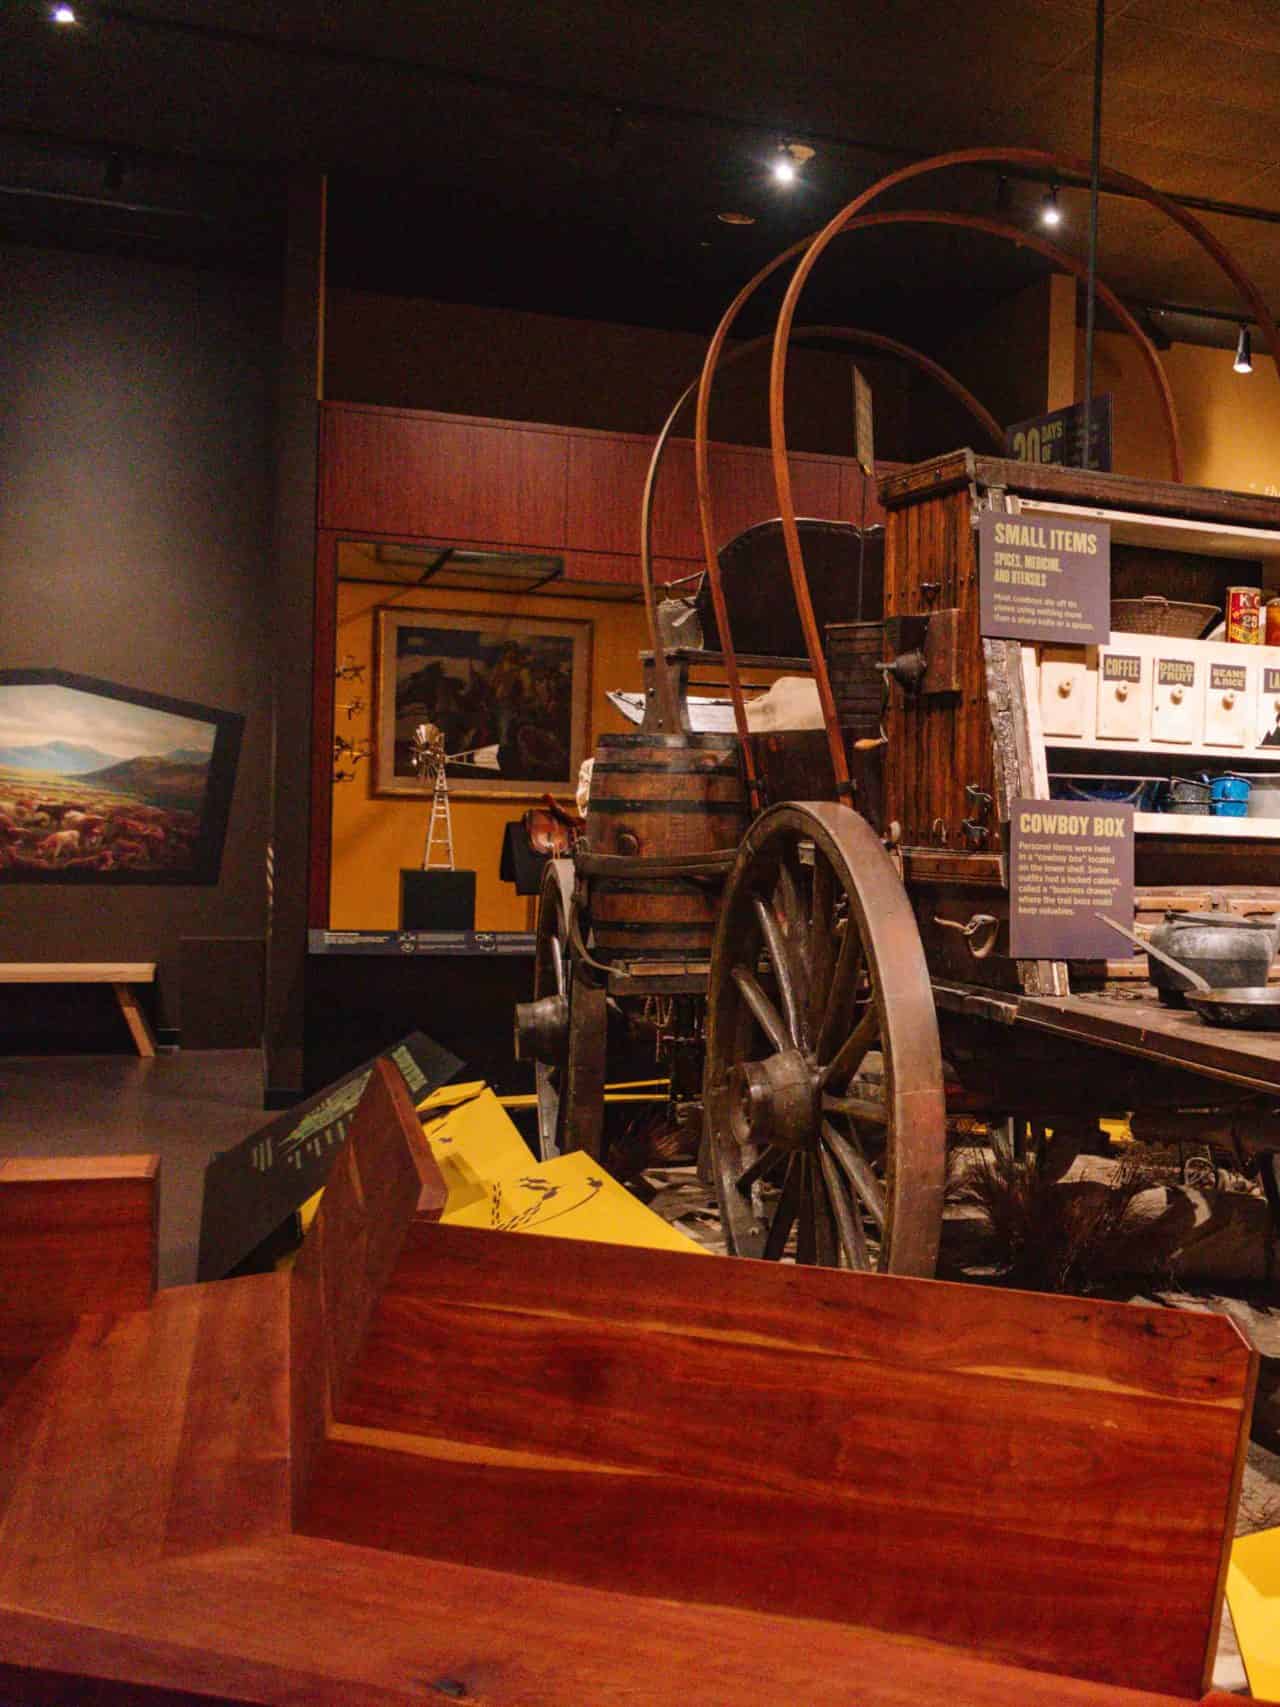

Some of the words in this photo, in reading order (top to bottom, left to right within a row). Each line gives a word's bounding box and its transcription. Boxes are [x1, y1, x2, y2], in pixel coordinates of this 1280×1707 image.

[1041, 420, 1063, 443] DAYS
[994, 521, 1047, 549] SMALL
[1049, 529, 1097, 555] ITEMS
[993, 552, 1022, 567] SPICES,
[1024, 555, 1063, 572] MEDICINE,
[993, 569, 1010, 583] AND
[1011, 570, 1047, 588] UTENSILS
[1105, 658, 1140, 678] COFFEE
[1159, 662, 1194, 674] DRIED
[1160, 671, 1193, 682] FRUIT
[1212, 669, 1246, 679] BEANS
[1020, 813, 1089, 835] COWBOY
[1093, 817, 1126, 838] BOX
